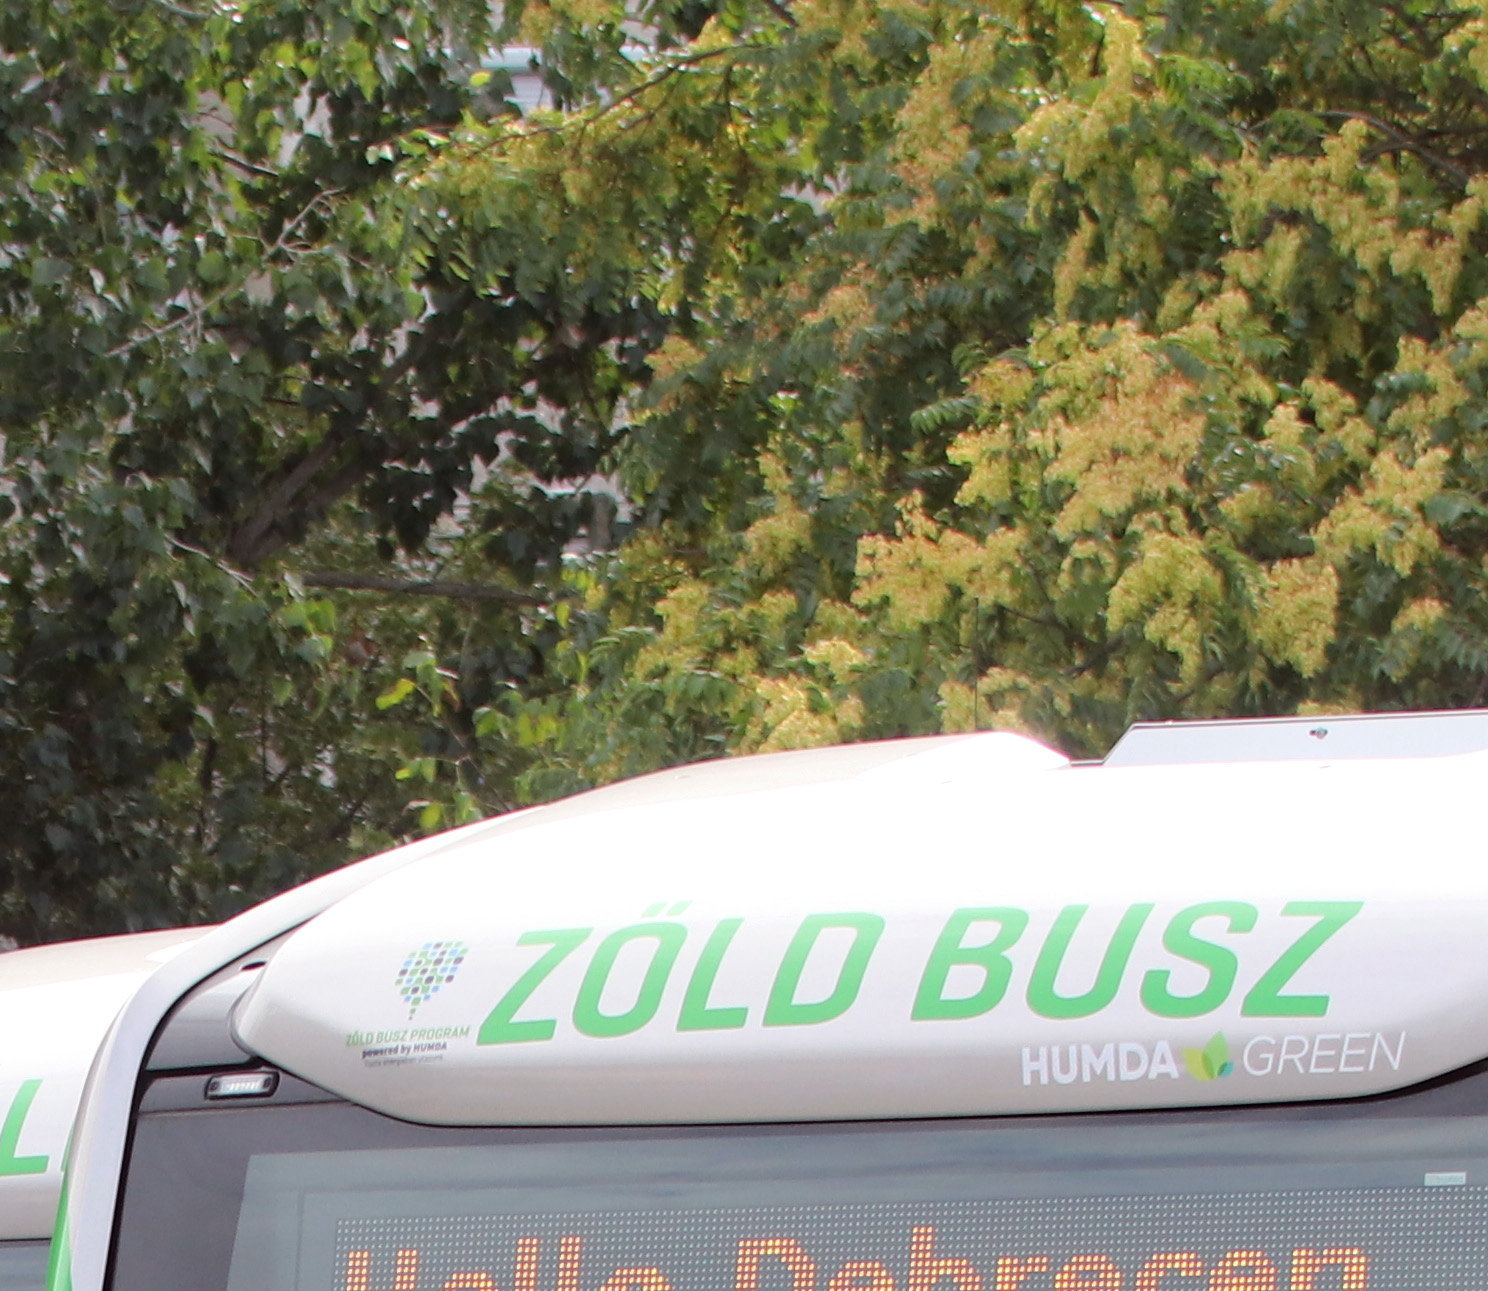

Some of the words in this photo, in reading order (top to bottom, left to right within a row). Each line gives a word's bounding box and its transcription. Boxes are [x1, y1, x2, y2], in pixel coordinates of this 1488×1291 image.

[477, 900, 886, 1046] ZÖLD
[910, 899, 1365, 1021] BUSZ
[362, 1045, 399, 1059] powered
[400, 1044, 412, 1056] by
[413, 1041, 447, 1053] HUMDA
[376, 1029, 409, 1043] BUSZ
[410, 1025, 470, 1041] PROGRAM
[1022, 1039, 1180, 1086] HUMDA
[1242, 1030, 1407, 1077] GREEN
